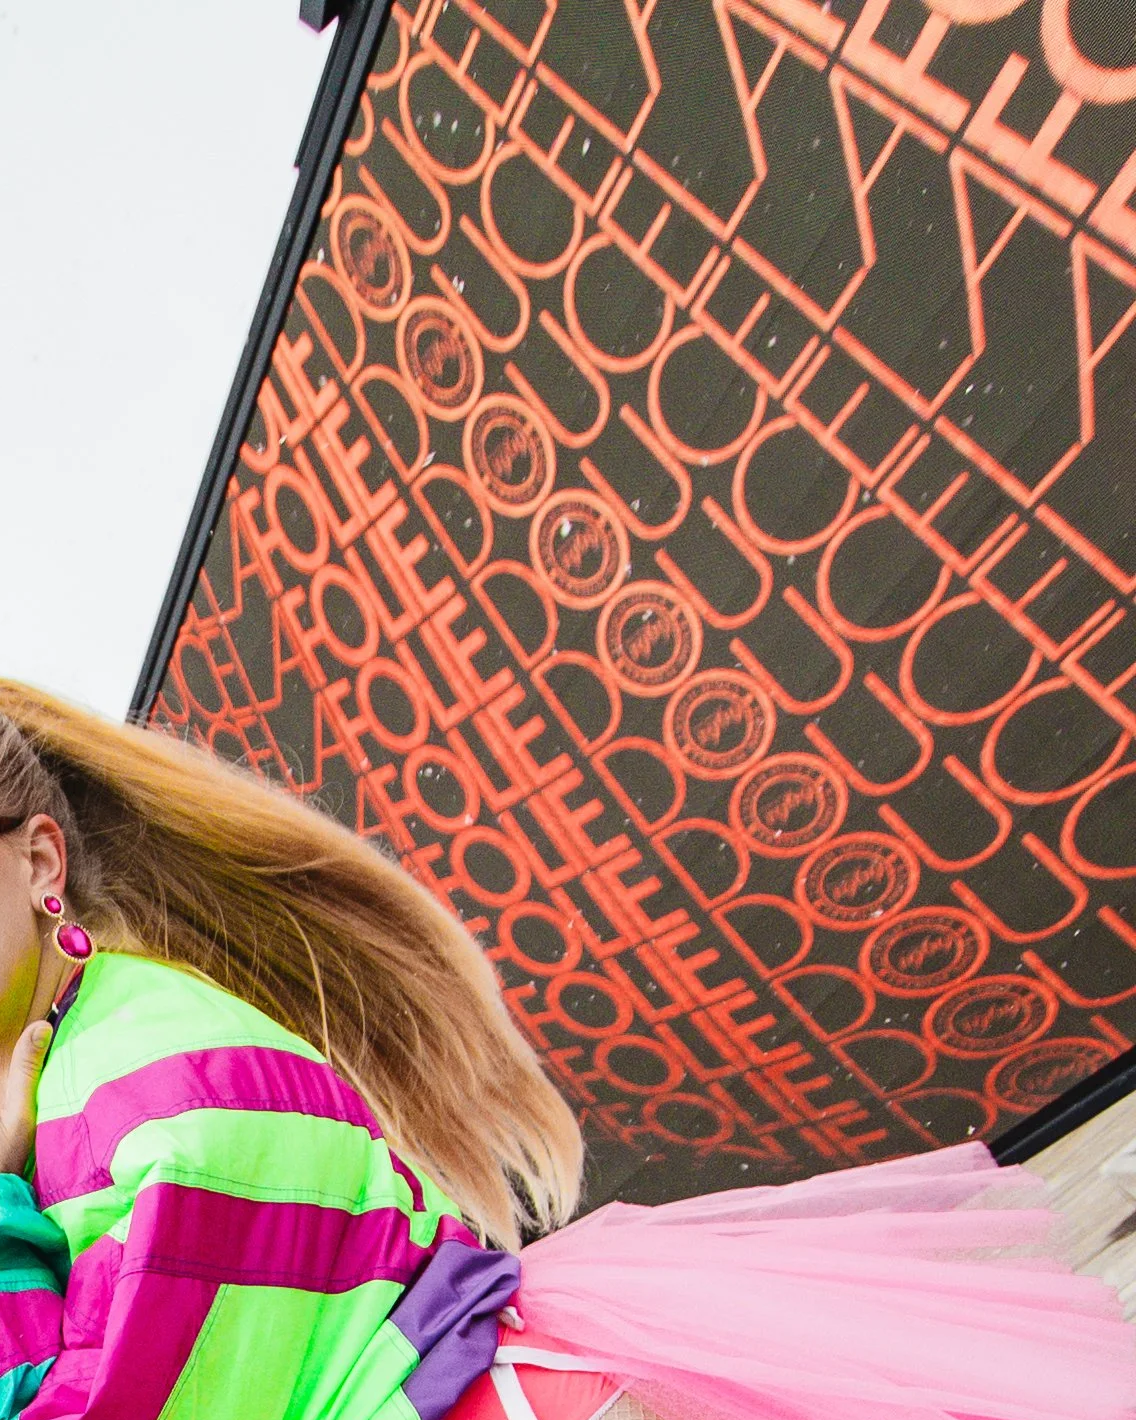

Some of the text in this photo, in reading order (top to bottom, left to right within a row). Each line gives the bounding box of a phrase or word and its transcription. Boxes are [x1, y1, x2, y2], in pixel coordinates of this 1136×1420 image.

[235, 395, 399, 594] FOLIE
[260, 689, 365, 791] LA
[321, 595, 516, 772] FOLIE
[731, 63, 950, 331] LA
[363, 686, 574, 852] FOLIE
[833, 145, 1073, 419] LA
[219, 598, 323, 711] LA
[277, 499, 456, 686] FOLIE
[411, 769, 632, 916] FOLIE
[500, 922, 749, 1048] FOLIE
[546, 992, 805, 1104] FOLIE
